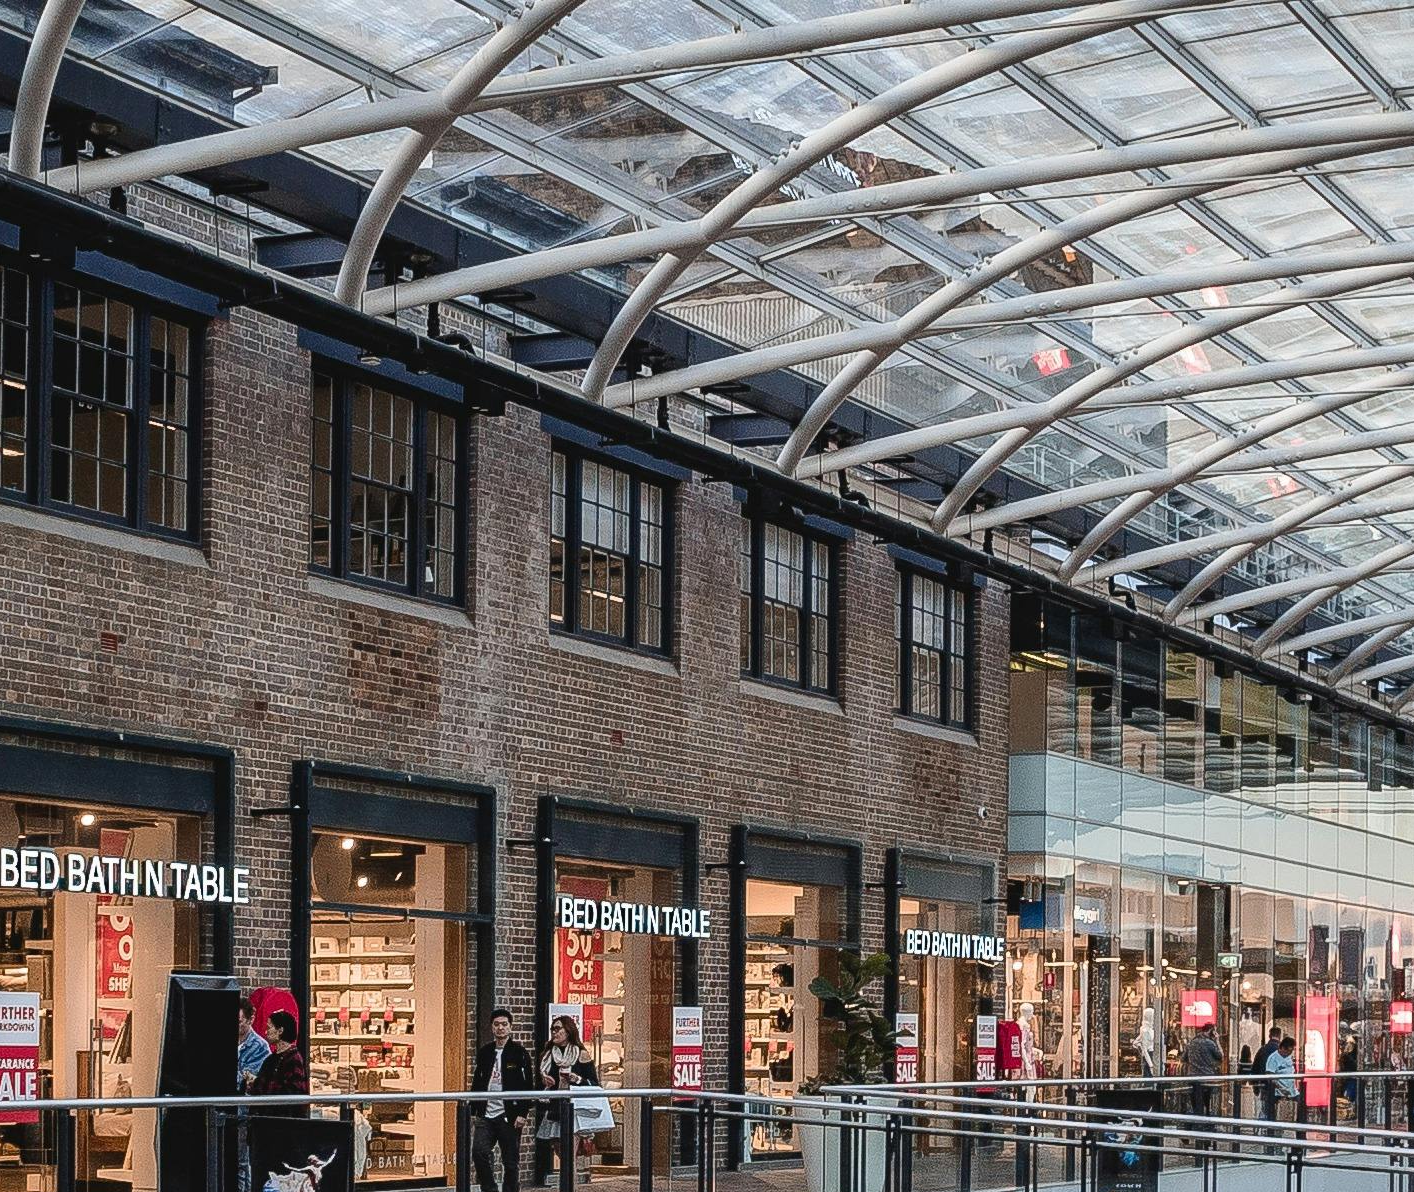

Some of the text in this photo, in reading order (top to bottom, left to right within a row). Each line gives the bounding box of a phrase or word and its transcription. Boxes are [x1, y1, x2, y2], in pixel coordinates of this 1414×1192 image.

[0, 848, 250, 904] BED BATH N TABLE
[561, 897, 711, 938] BED BATH N TABLE
[906, 929, 1005, 961] BED BATH N TABLE
[673, 1063, 702, 1088] SALE
[896, 1062, 917, 1082] SALE
[977, 1062, 996, 1081] SALE
